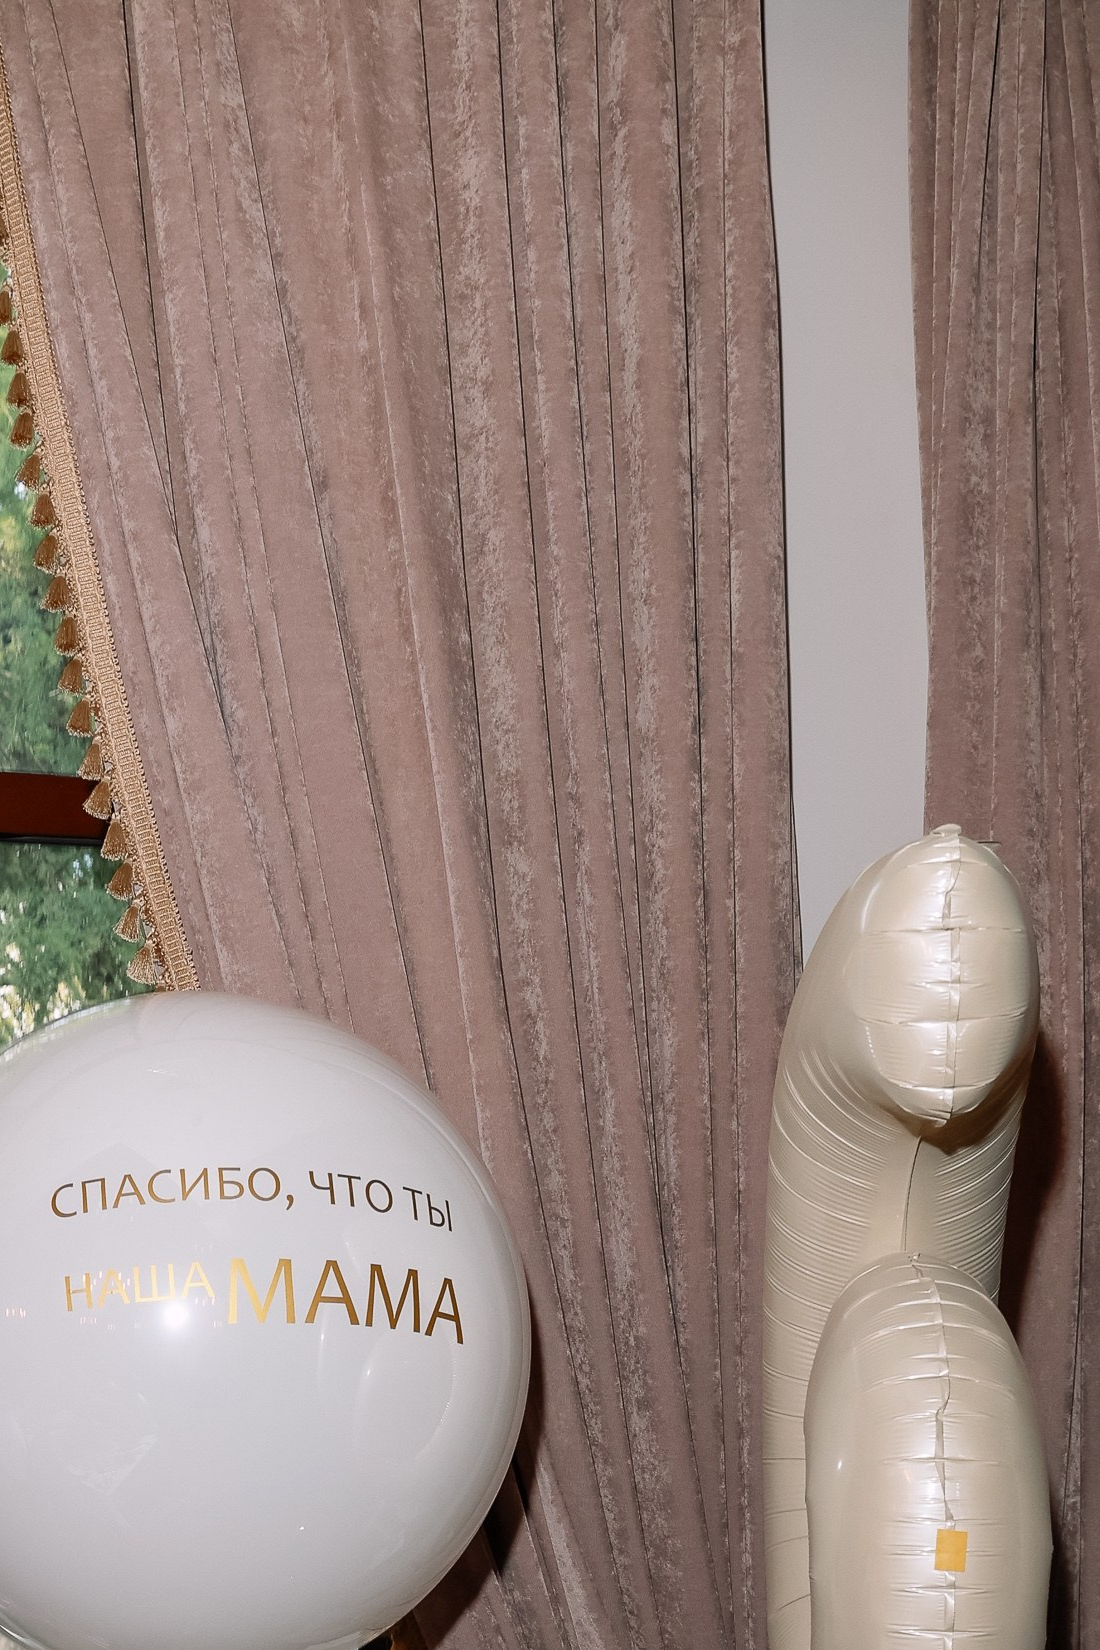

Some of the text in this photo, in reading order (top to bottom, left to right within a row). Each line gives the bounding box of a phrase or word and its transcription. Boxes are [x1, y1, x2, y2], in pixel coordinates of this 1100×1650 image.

[50, 1166, 454, 1232] СПАСИБО, ЧТО ТЫ
[64, 1258, 465, 1346] НАША МАМА
